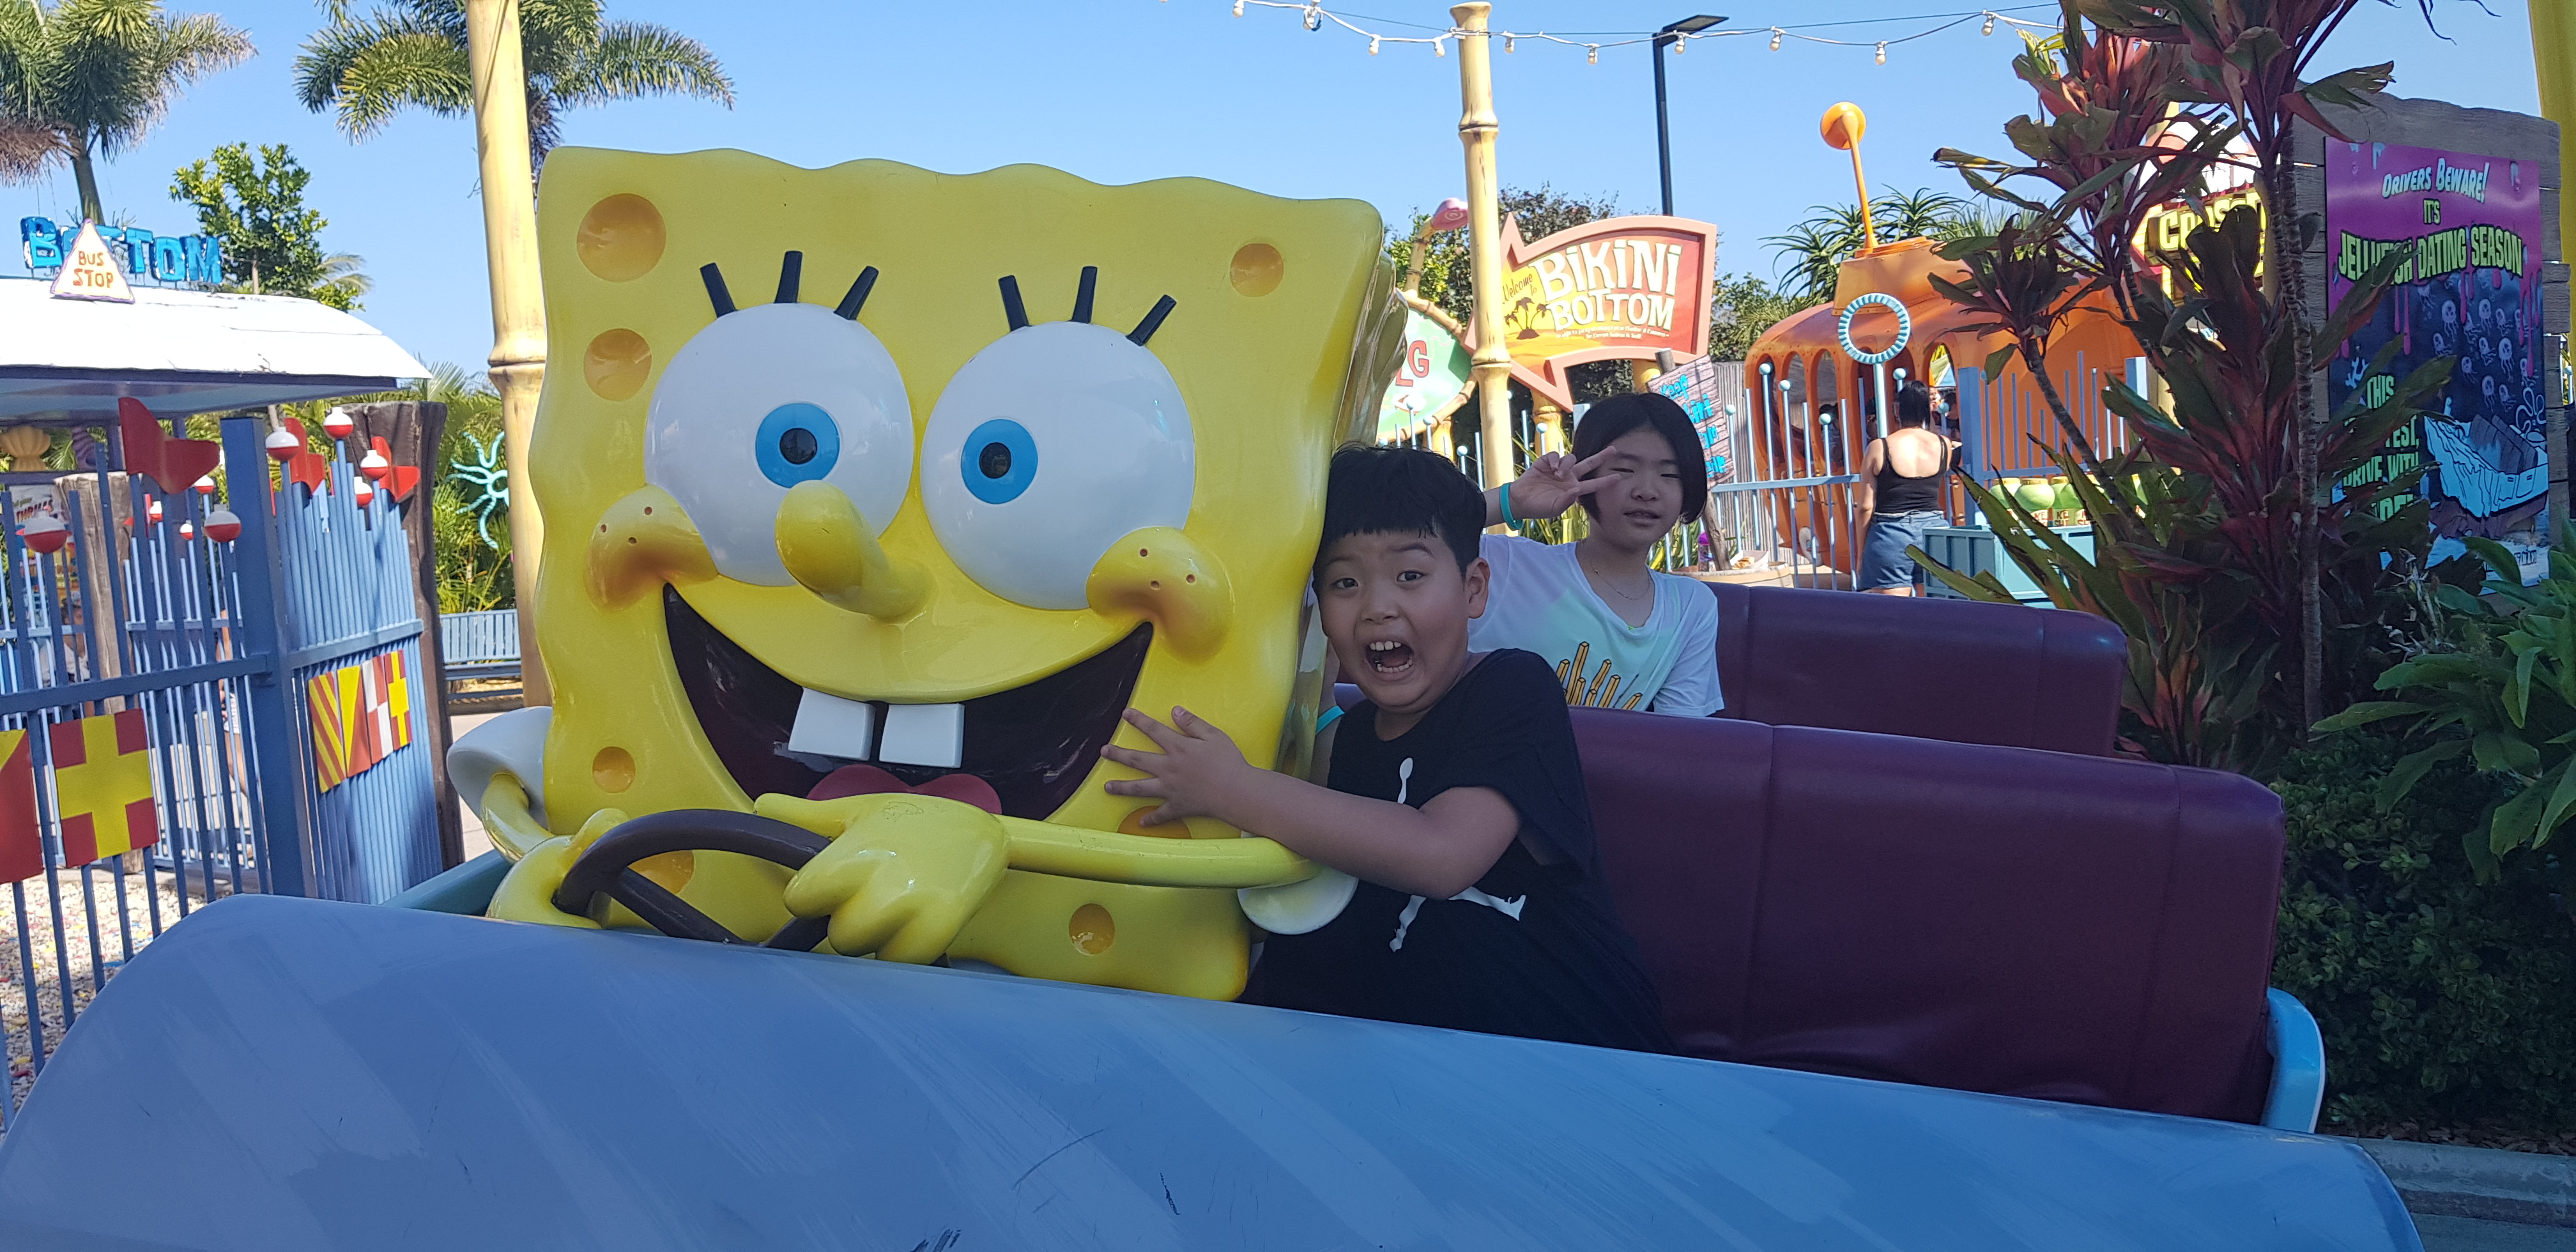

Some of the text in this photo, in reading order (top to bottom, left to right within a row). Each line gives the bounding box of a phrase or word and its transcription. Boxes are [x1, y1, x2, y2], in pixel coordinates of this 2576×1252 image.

[2381, 158, 2490, 204] DRIVERS BEWARE!
[2423, 199, 2441, 224] IT'S
[79, 250, 103, 266] BUS
[2418, 228, 2467, 280] DATING
[2471, 225, 2523, 277] SEASON
[73, 268, 114, 288] STOP
[1502, 274, 1533, 304] Welcome
[1529, 284, 1537, 296] to
[1546, 288, 1675, 331] BOTTOM
[2366, 374, 2395, 409] THIS
